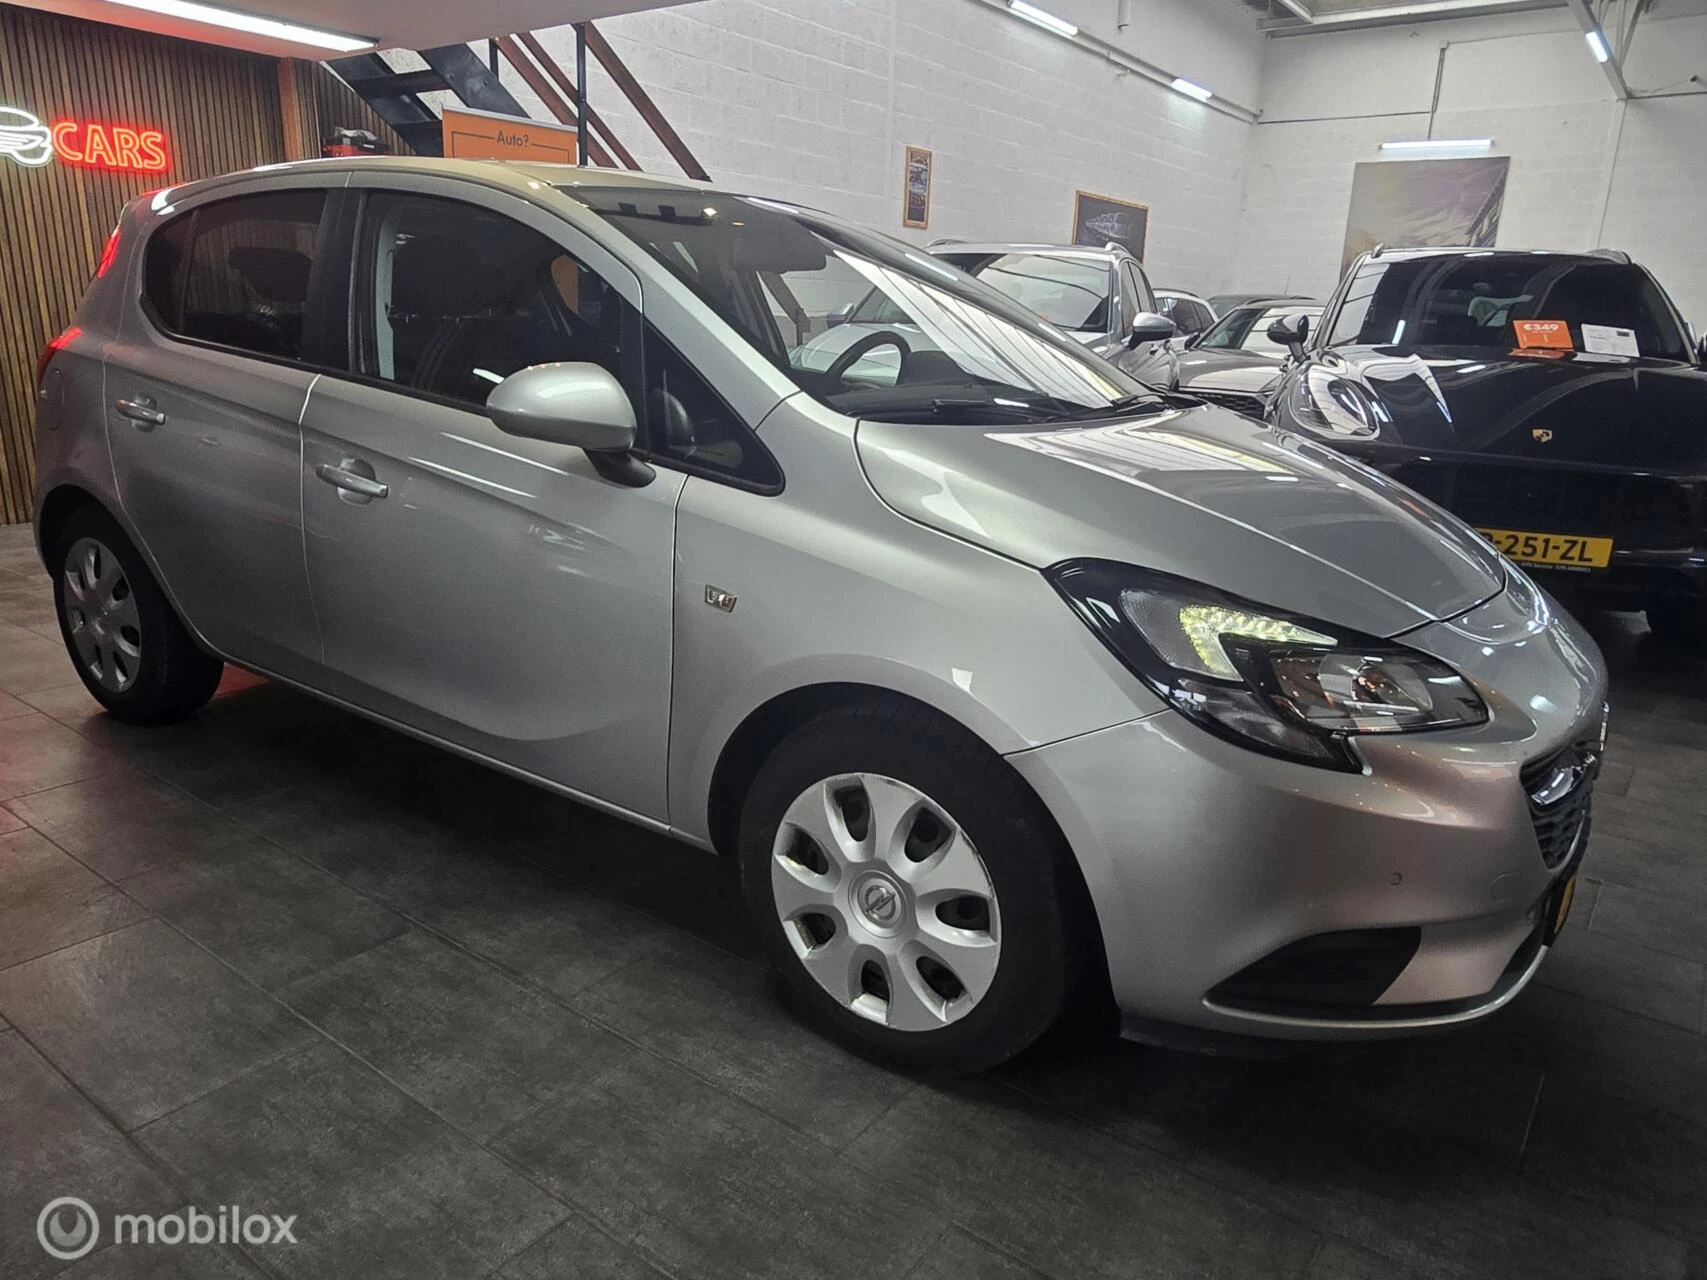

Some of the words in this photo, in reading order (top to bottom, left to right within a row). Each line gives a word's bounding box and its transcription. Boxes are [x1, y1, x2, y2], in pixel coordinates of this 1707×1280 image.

[52, 122, 166, 170] CARS
[496, 130, 529, 148] Auto?
[1523, 323, 1559, 332] €349
